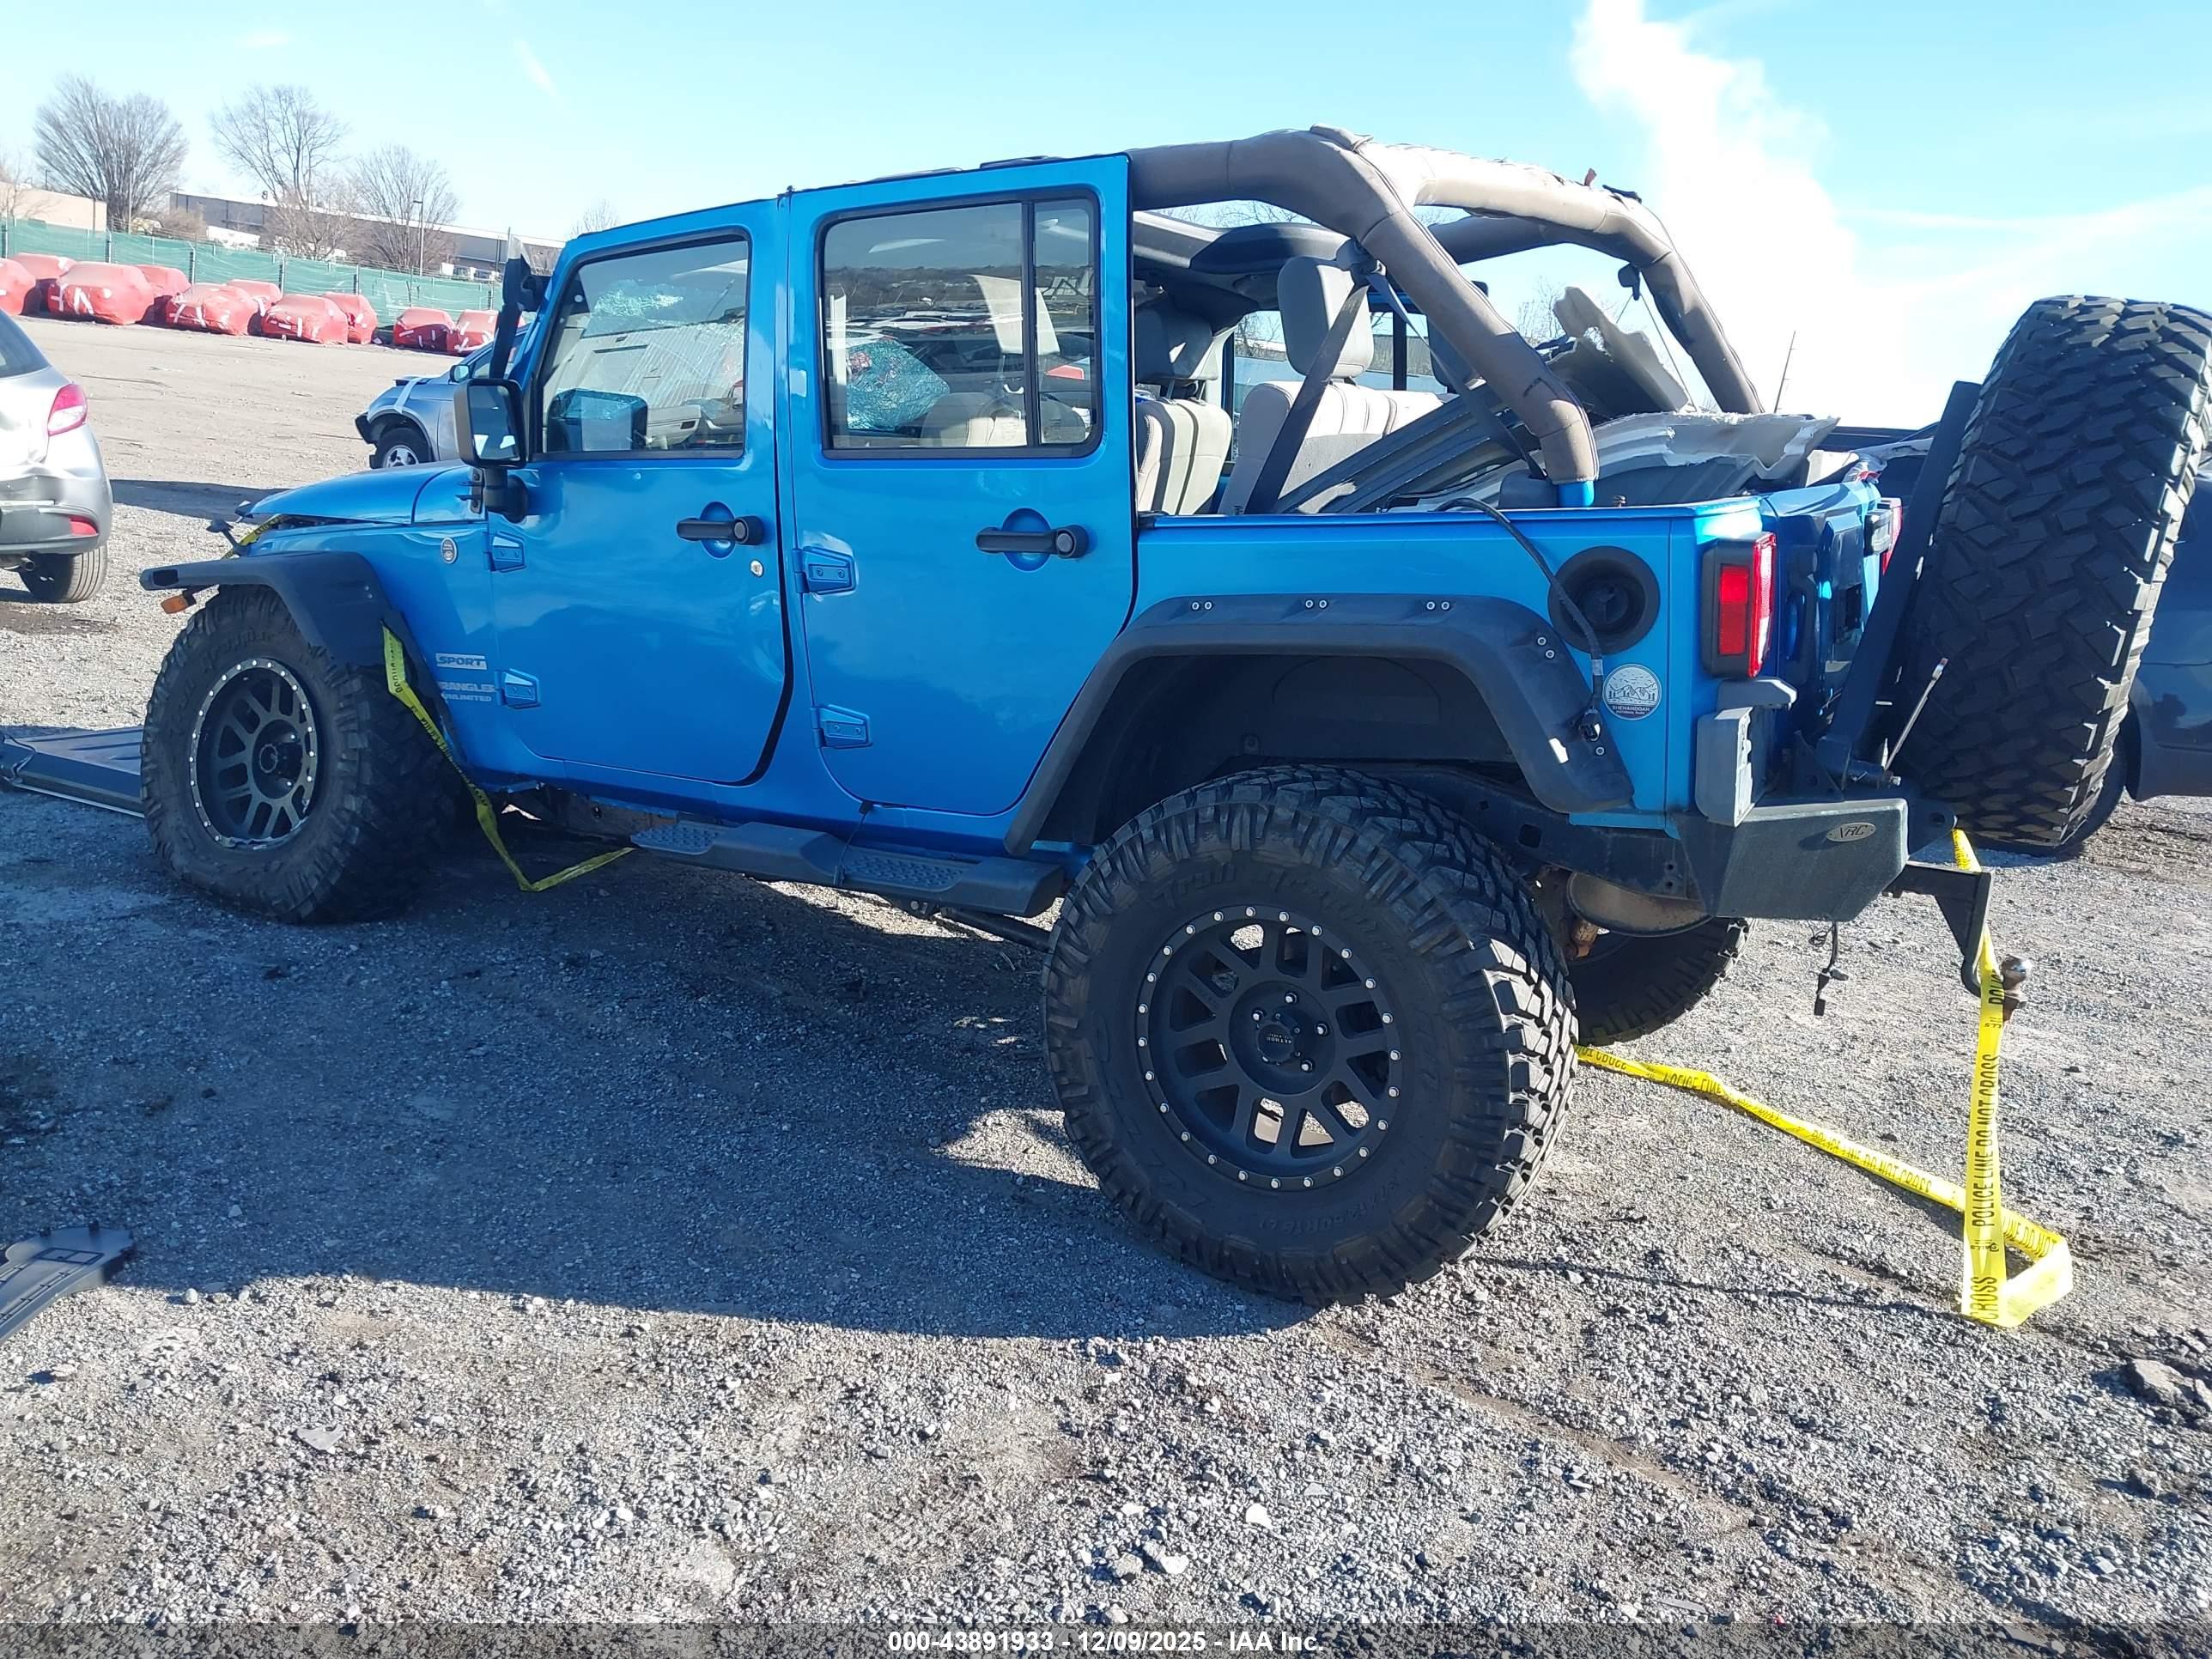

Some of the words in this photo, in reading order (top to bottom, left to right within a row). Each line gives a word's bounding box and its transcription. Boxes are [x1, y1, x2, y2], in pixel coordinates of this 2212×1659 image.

[439, 657, 484, 667] SPORT
[1978, 1054, 1999, 1097] CROSS
[1977, 1099, 1995, 1126] NOT
[1975, 1129, 1993, 1147] DO
[1974, 1151, 1993, 1179] LINE
[1972, 1182, 1995, 1227] POLICE
[1969, 1276, 2000, 1320] CROSS
